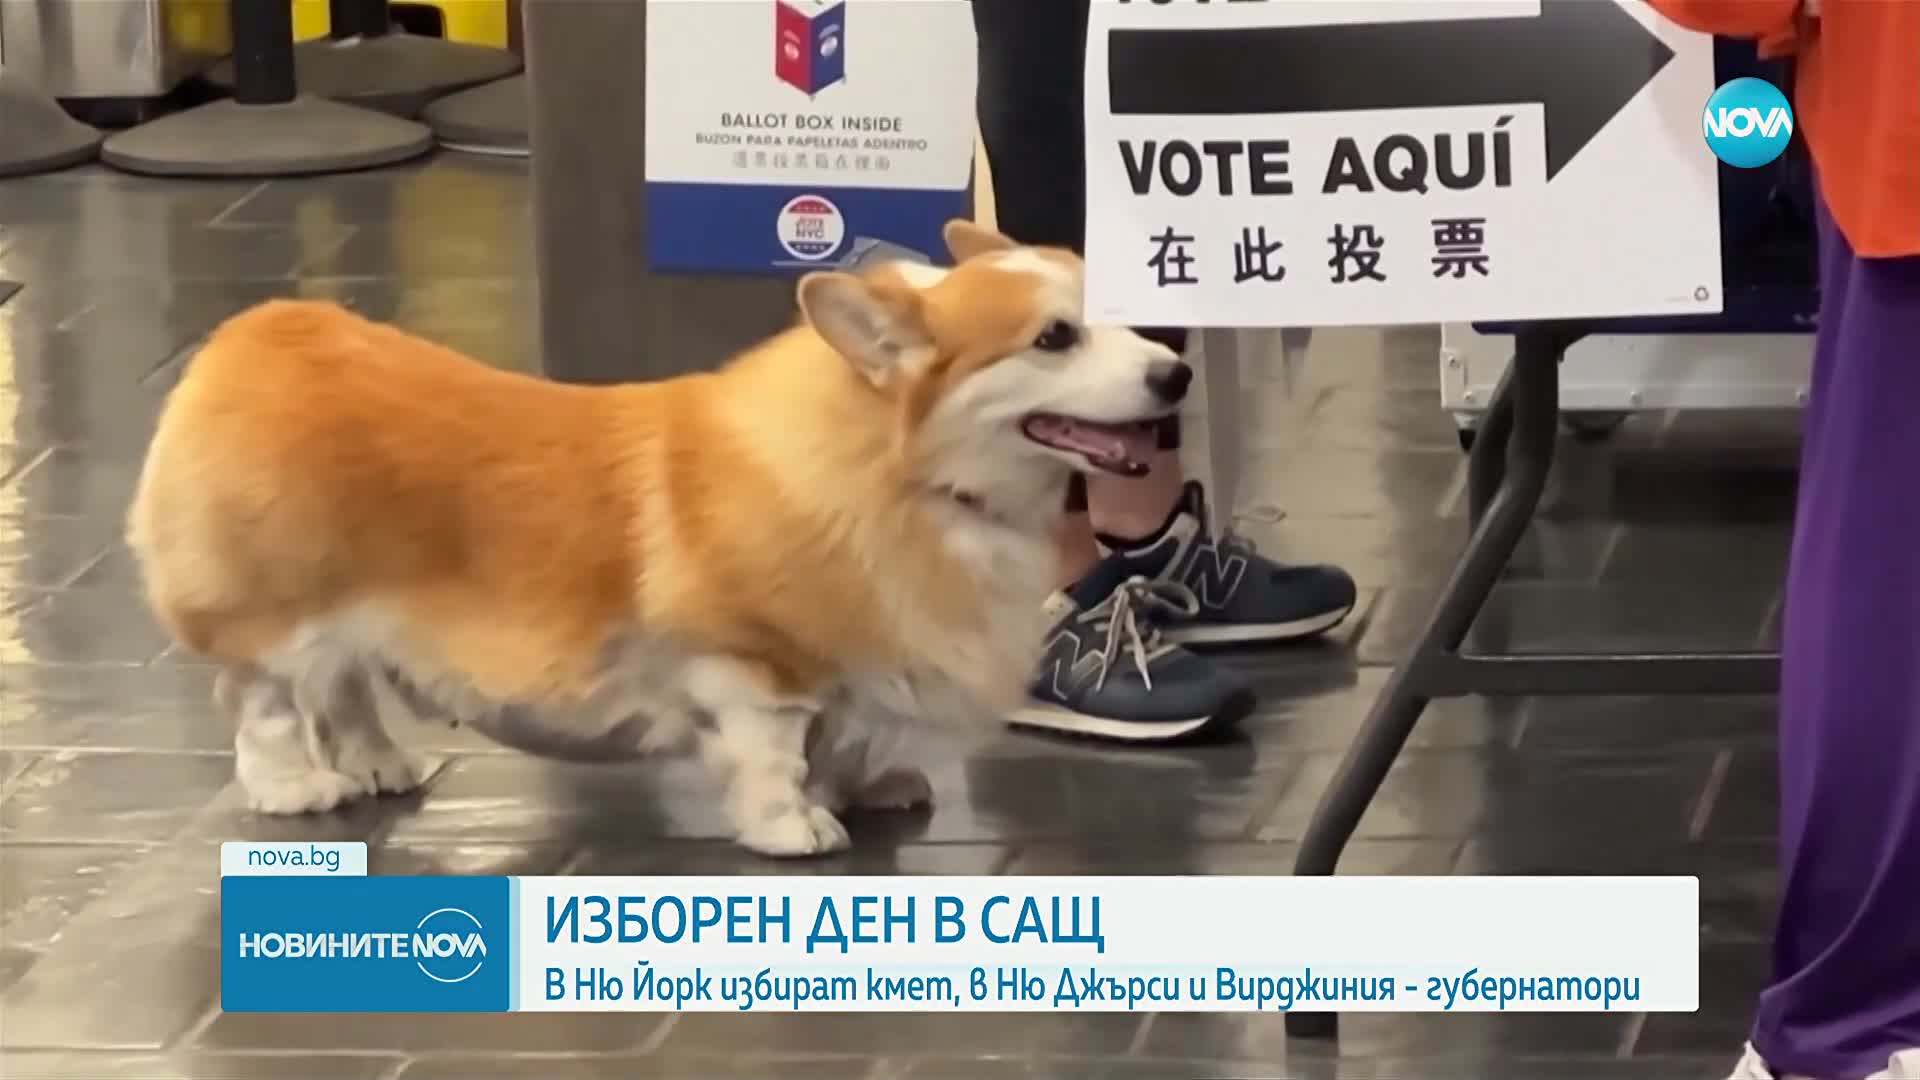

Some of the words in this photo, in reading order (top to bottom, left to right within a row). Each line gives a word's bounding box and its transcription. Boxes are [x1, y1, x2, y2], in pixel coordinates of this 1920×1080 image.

[721, 112, 787, 128] BALLOT
[795, 114, 833, 131] BOX
[842, 116, 902, 133] INSIDE
[746, 134, 782, 146] PARA
[787, 136, 859, 149] PAPELETAS
[863, 138, 928, 151] ADENTRO
[1118, 139, 1293, 197] VOTE
[1321, 115, 1514, 195] AQUÍ
[1148, 217, 1490, 287] 在此投票
